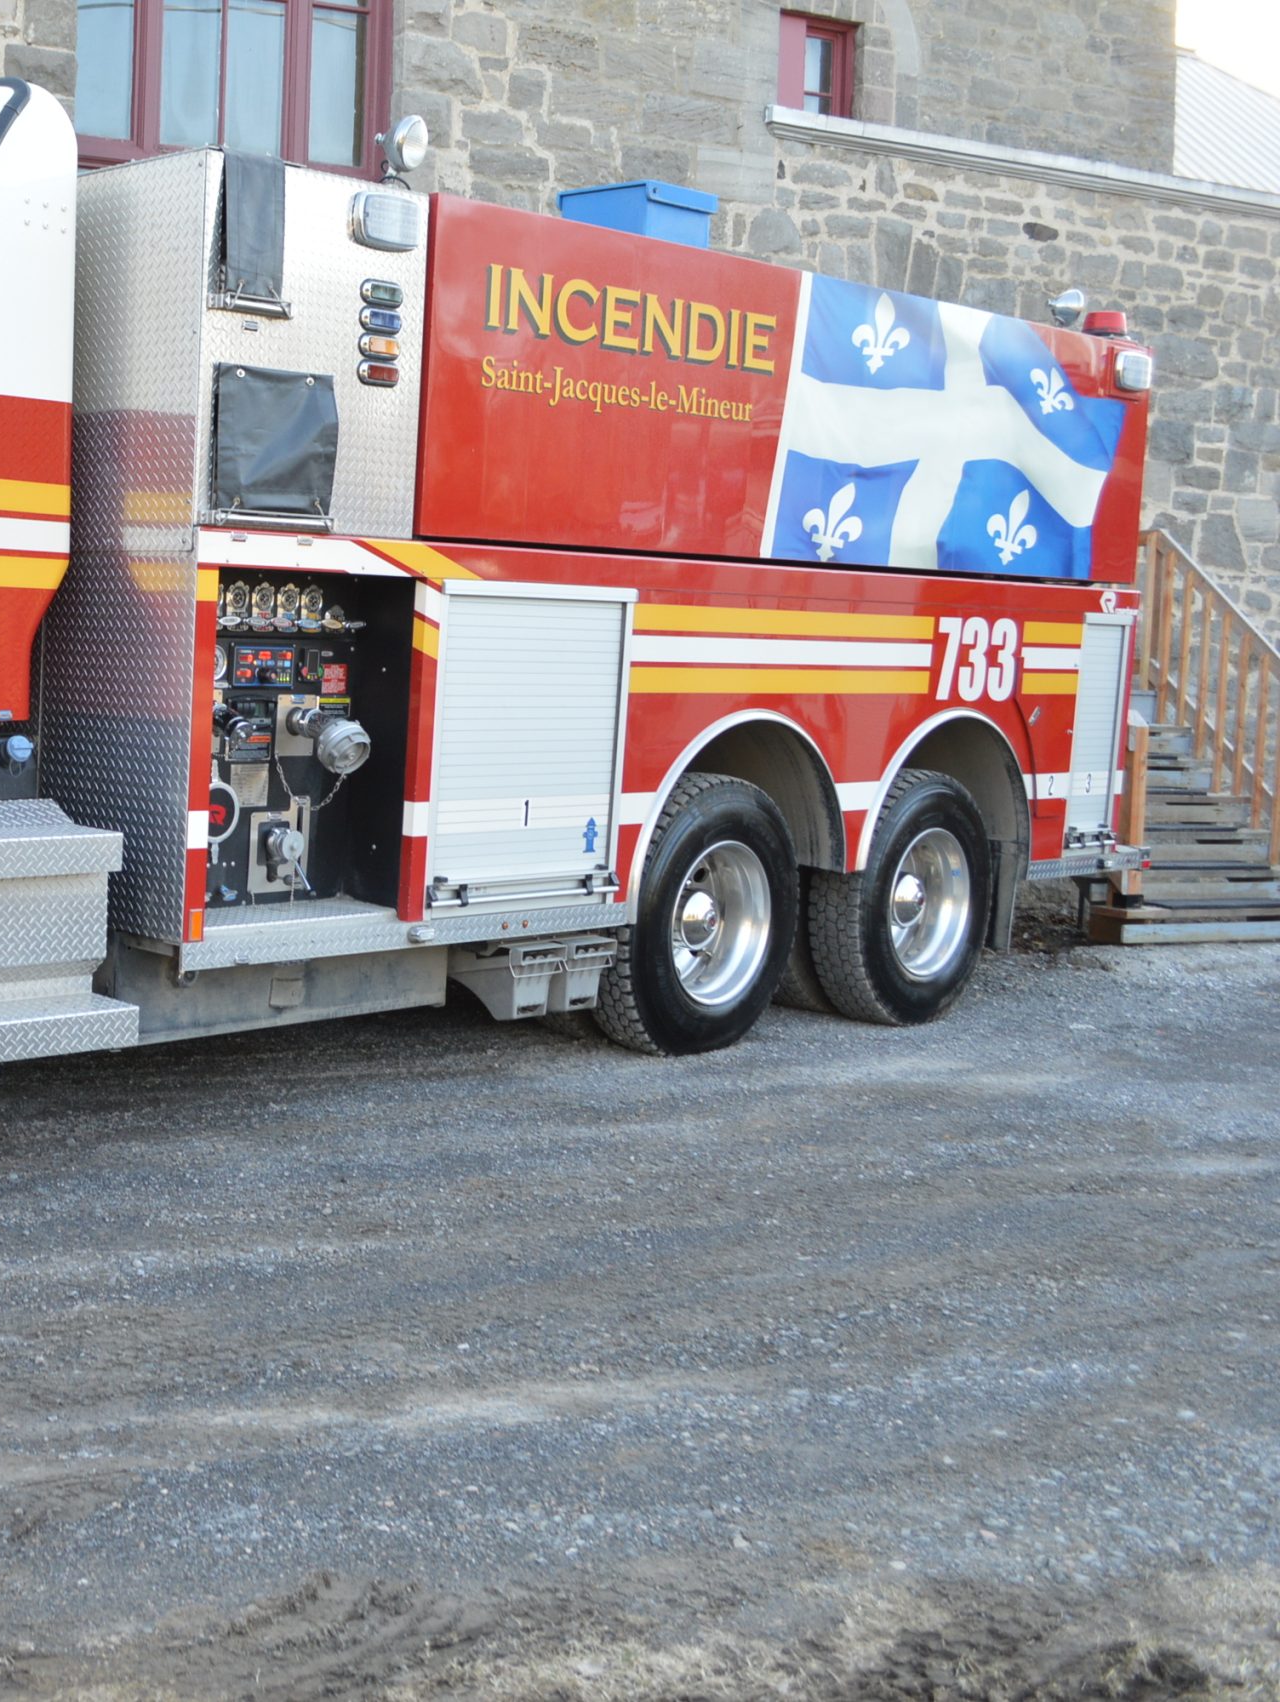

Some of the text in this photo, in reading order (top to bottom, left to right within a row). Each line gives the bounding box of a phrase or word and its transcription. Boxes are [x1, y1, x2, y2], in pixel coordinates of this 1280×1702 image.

[485, 263, 777, 374] INCENDIE
[481, 356, 753, 422] Saint-Jacques-le-Mineur
[935, 616, 1018, 702] 733
[524, 799, 530, 827] 1
[1048, 773, 1092, 796] 2 3
